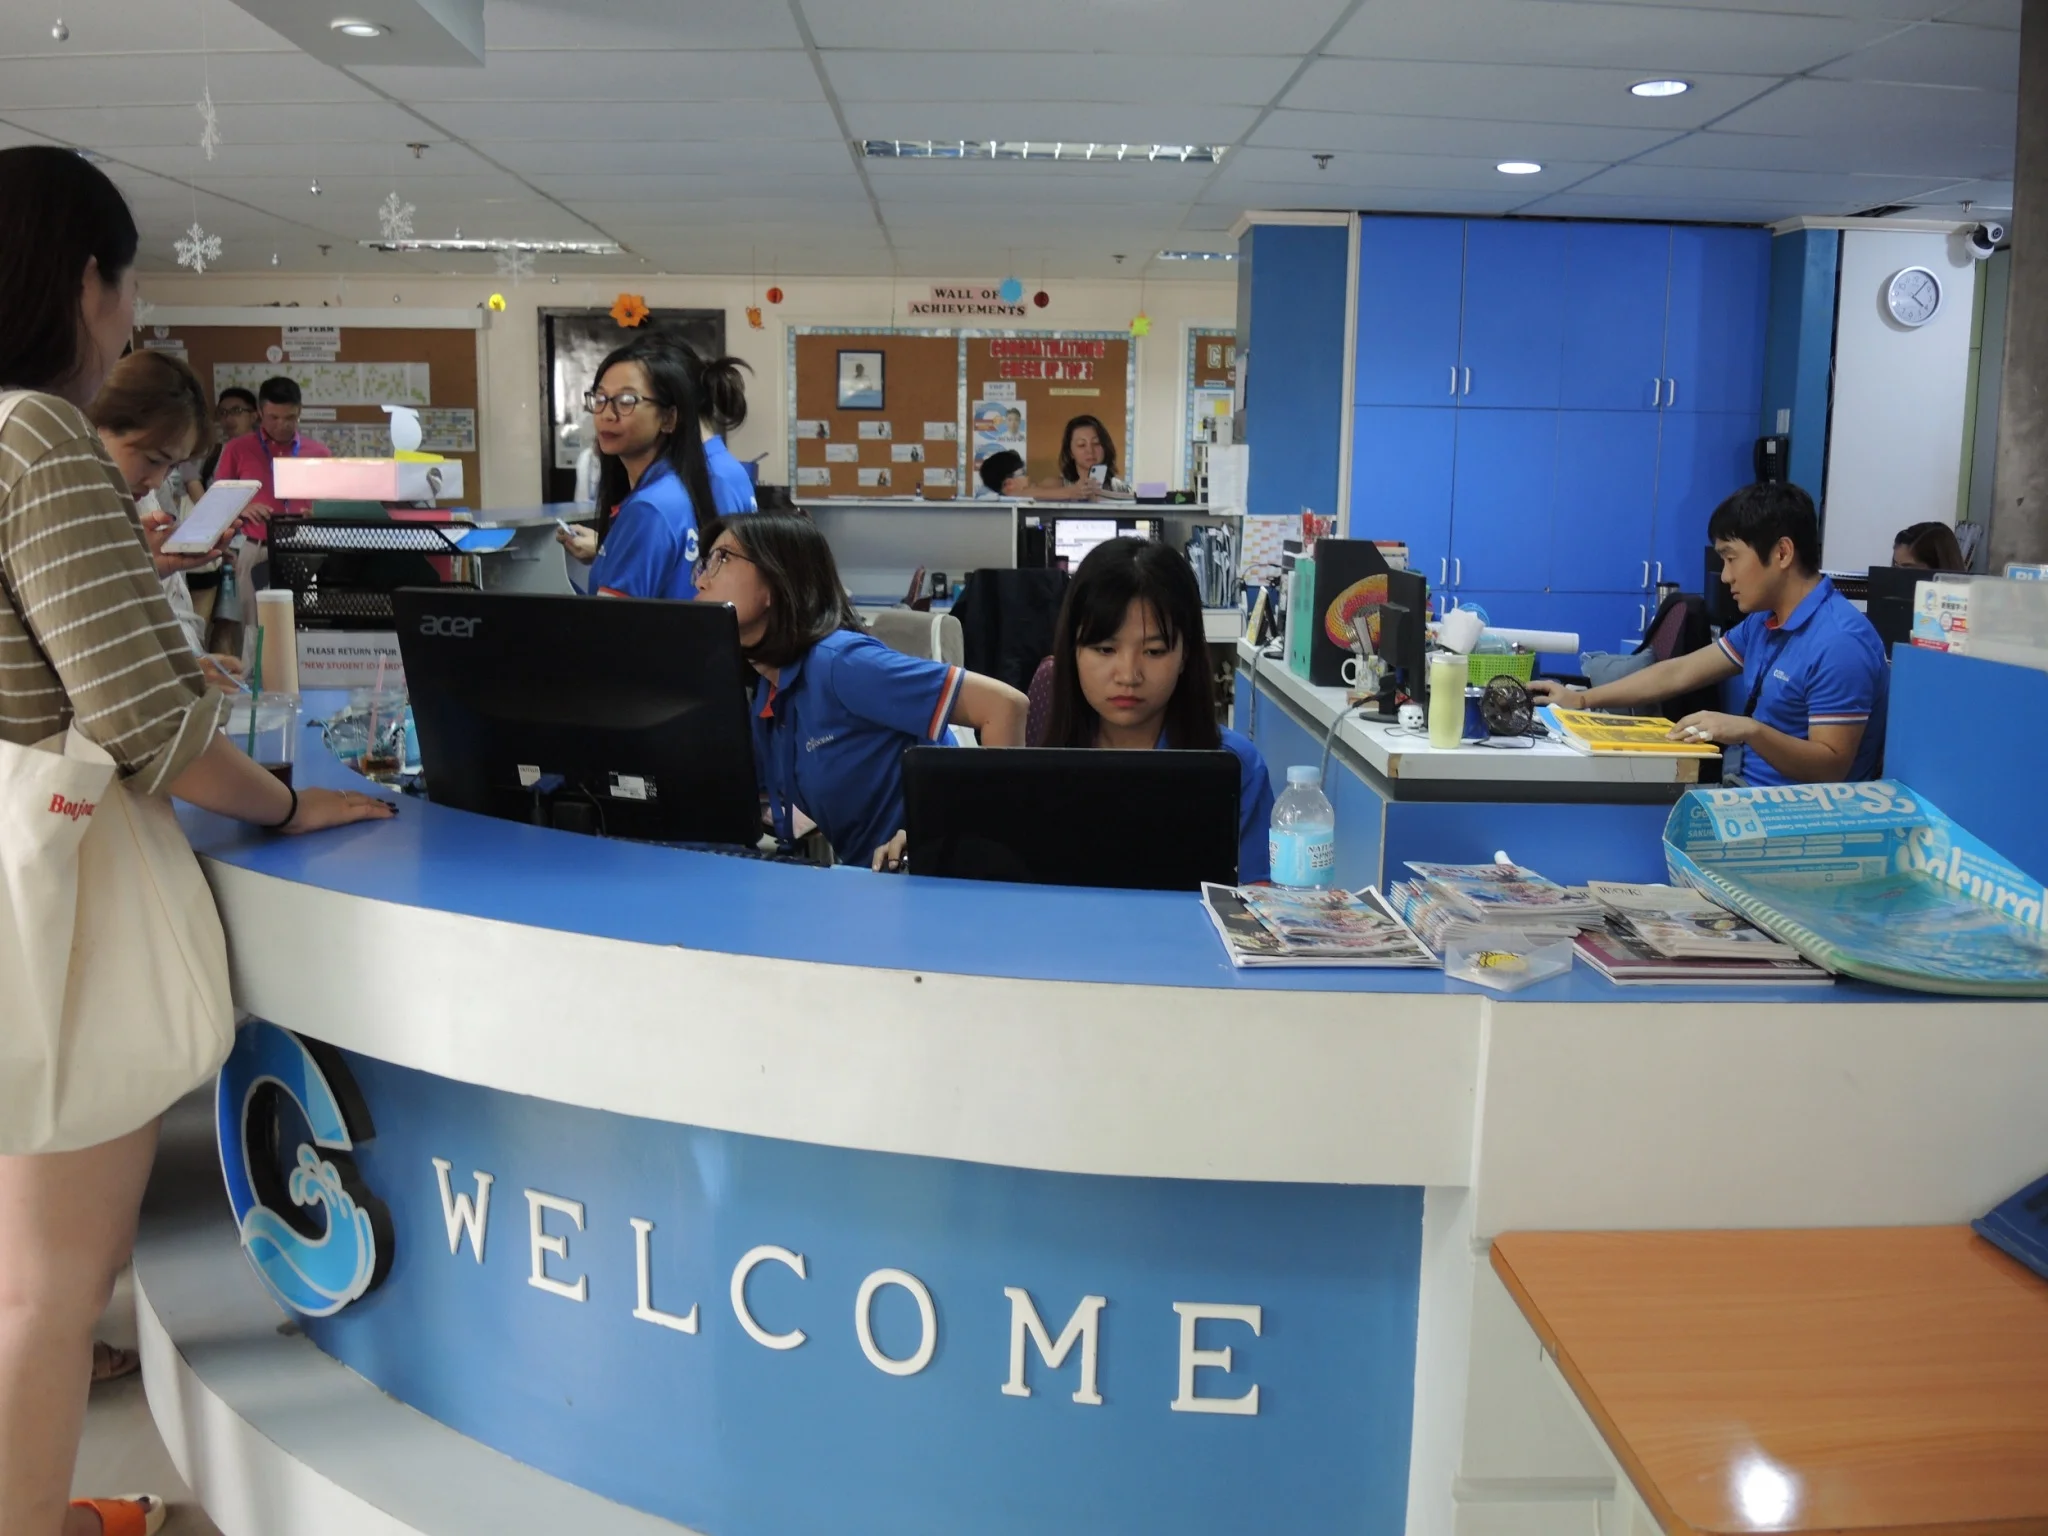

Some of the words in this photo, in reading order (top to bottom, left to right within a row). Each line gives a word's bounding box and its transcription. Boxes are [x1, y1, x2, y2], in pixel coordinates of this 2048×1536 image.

[934, 288, 974, 300] WALL
[981, 289, 1000, 300] OF
[911, 303, 1026, 316] ACHIEVEMENTS
[420, 615, 482, 638] acer
[306, 647, 335, 656] PLEASE
[338, 647, 371, 656] RETURN
[373, 648, 397, 656] YOUR
[327, 661, 364, 670] STUDENT
[366, 662, 376, 670] ID
[432, 1157, 1263, 1416] WELCOME
